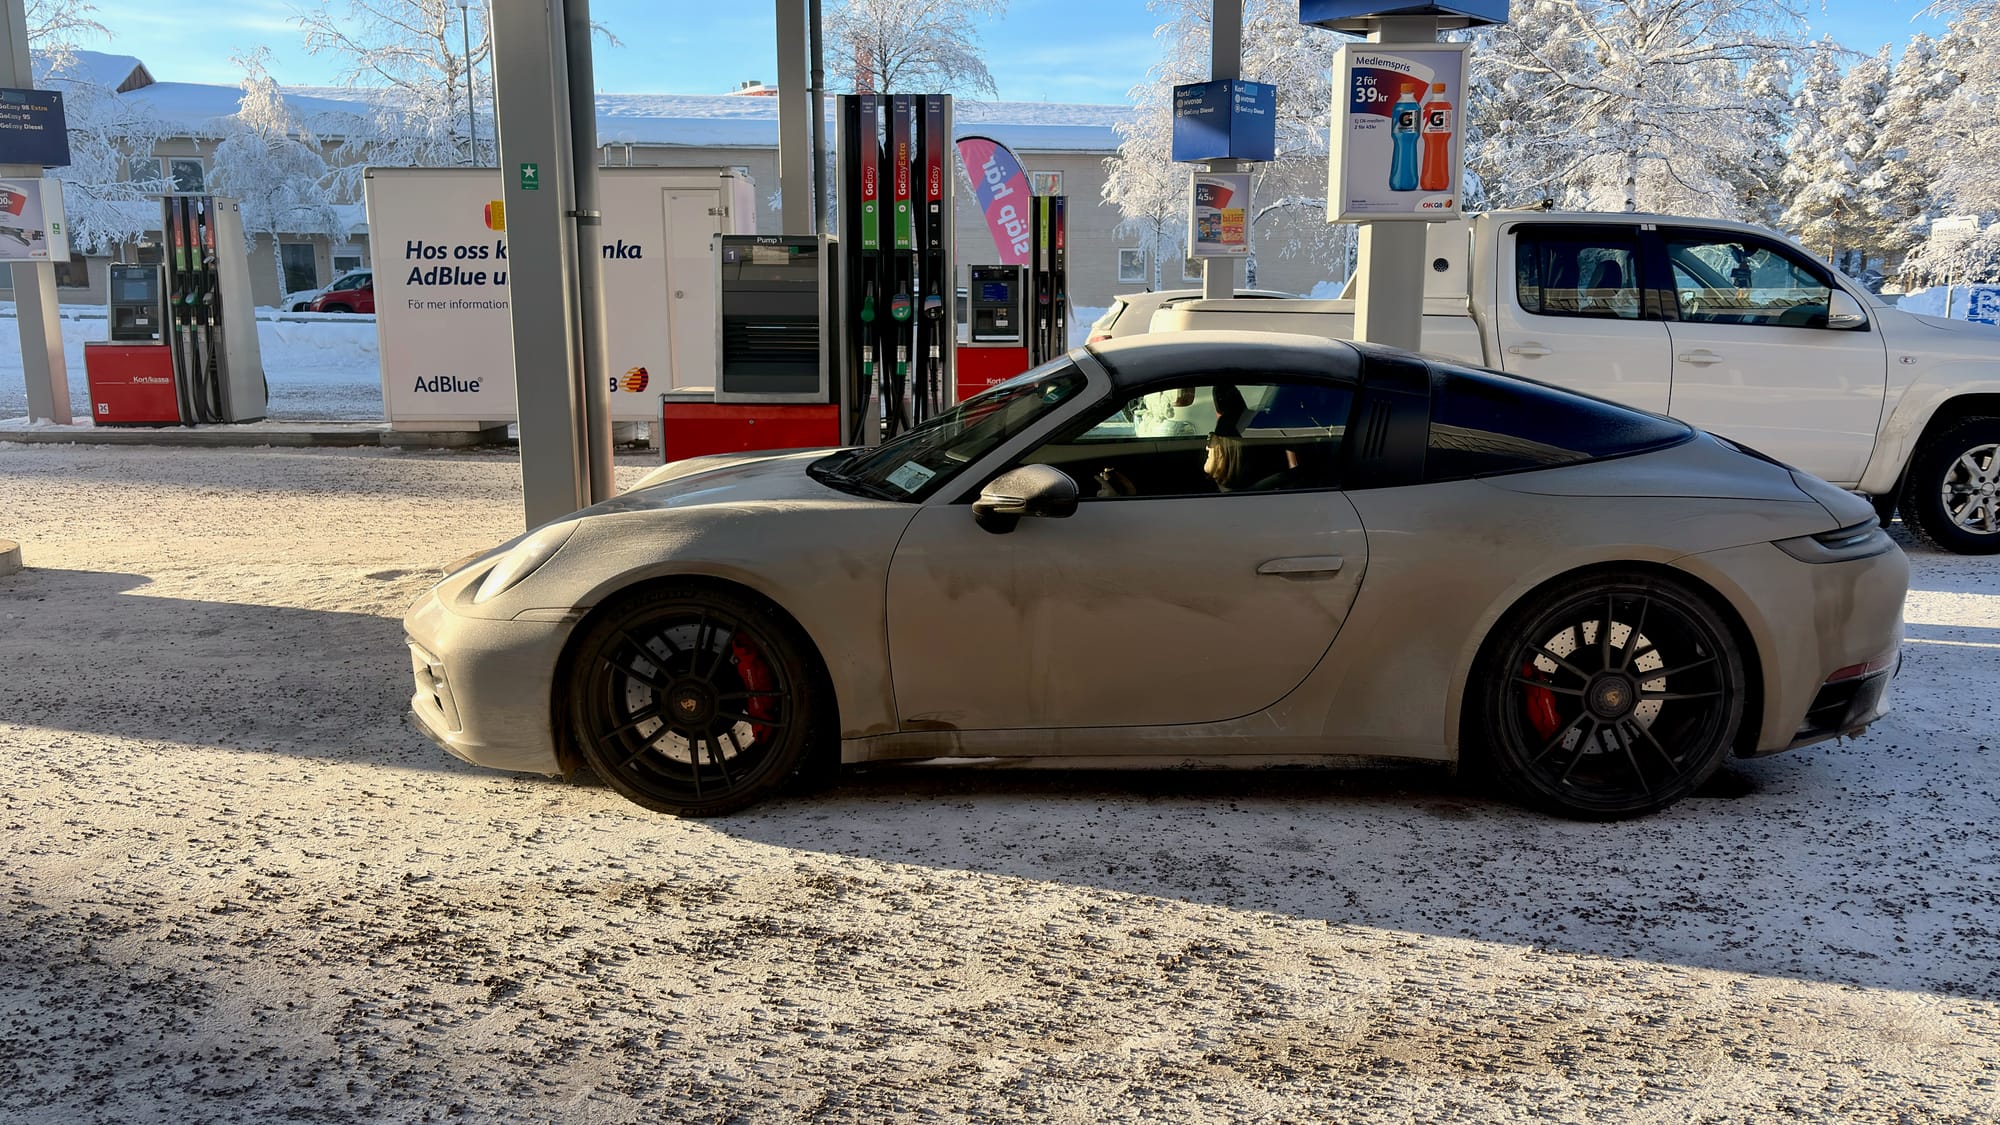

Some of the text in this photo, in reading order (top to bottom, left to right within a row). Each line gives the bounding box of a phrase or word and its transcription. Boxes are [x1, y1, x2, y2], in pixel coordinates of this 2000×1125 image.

[1356, 57, 1411, 72] Medlemspris
[1356, 76, 1377, 86] 2 för
[51, 95, 57, 103] 7
[865, 166, 875, 196] GoEasy
[931, 166, 940, 196] GoEasy
[756, 236, 778, 244] Pump
[406, 240, 447, 260] Hos
[454, 245, 489, 260] oss
[728, 250, 736, 260] 1
[406, 266, 487, 286] AdBlue
[408, 299, 509, 309] För mer information
